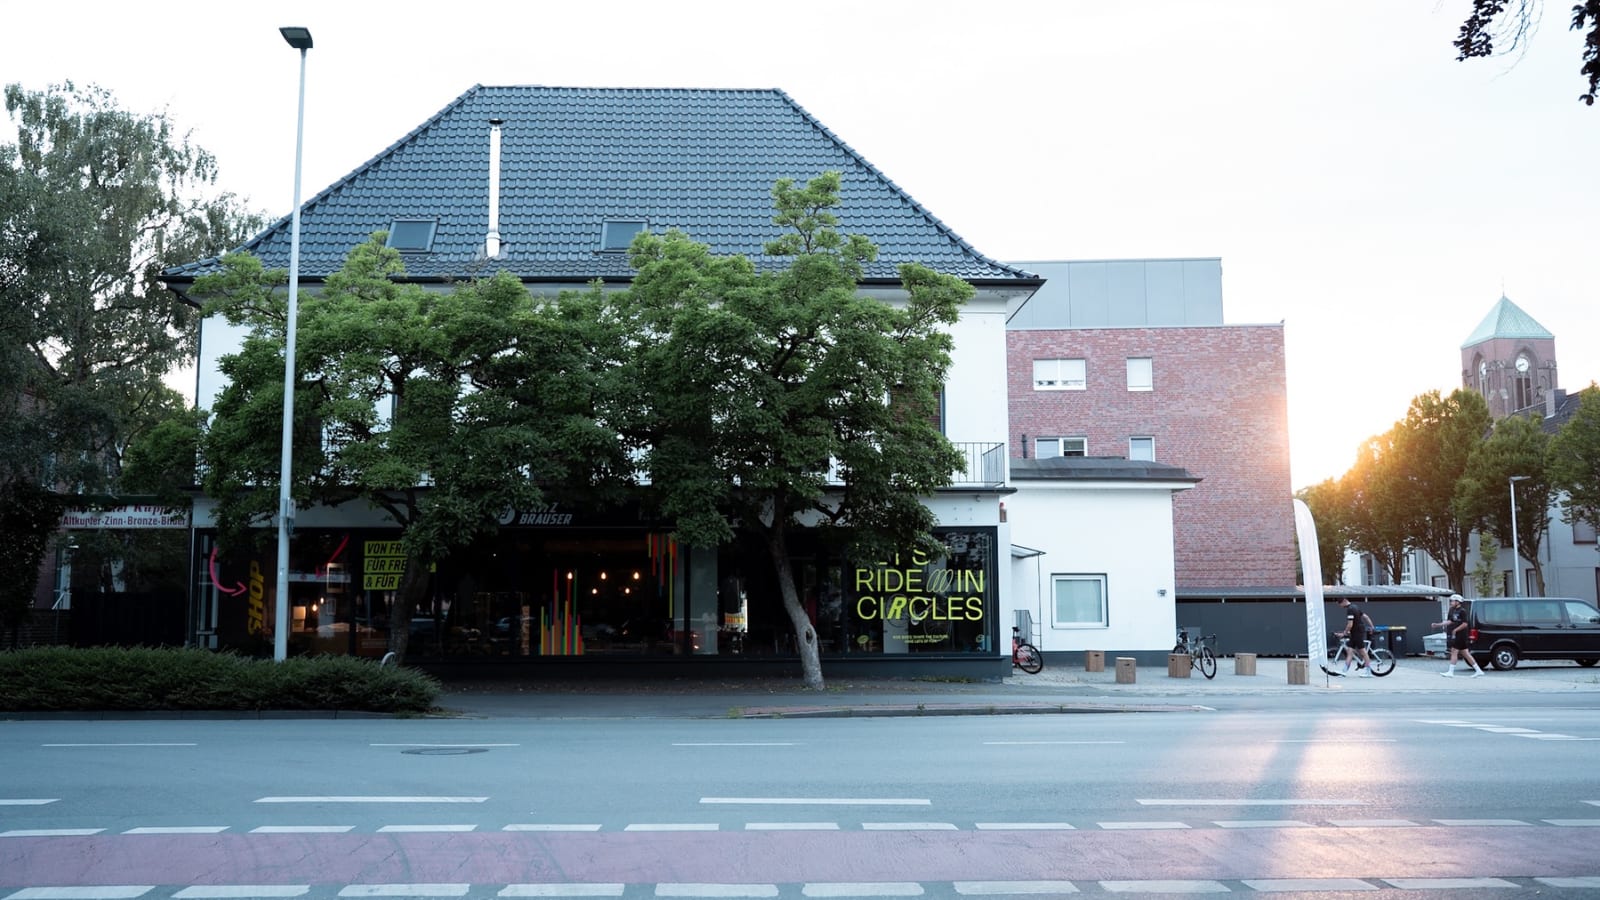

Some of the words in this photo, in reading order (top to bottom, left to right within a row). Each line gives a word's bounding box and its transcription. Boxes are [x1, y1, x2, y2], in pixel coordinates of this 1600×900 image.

[519, 513, 573, 525] BRAUSER
[367, 543, 388, 554] VON
[366, 558, 386, 571] FÜR
[365, 577, 373, 588] &
[375, 574, 395, 588] FÜR
[855, 569, 923, 592] RIDE
[957, 569, 984, 592] IN
[248, 560, 264, 636] SHOP
[856, 596, 984, 621] CIRCLES
